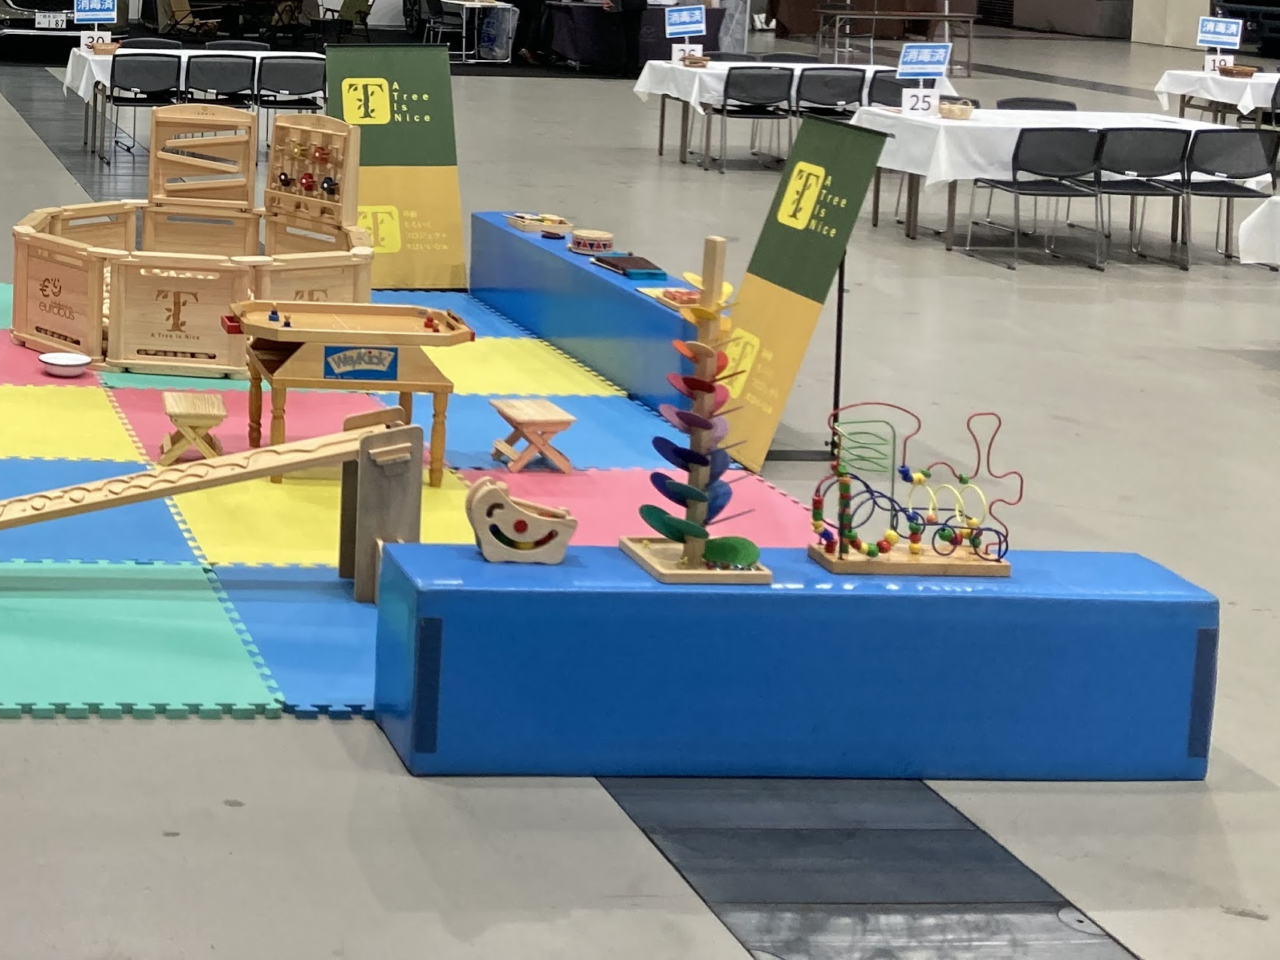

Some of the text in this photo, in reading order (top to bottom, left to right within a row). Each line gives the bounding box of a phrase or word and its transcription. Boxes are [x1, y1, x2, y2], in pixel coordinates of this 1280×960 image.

[903, 48, 947, 63] 消毒済
[392, 81, 400, 90] A
[393, 92, 429, 101] Tree
[909, 94, 932, 112] 25
[393, 103, 408, 112] Is
[394, 113, 431, 123] Nice
[824, 175, 832, 187] A
[820, 189, 847, 208] Tree
[814, 204, 826, 218] Is
[808, 218, 837, 238] Nice
